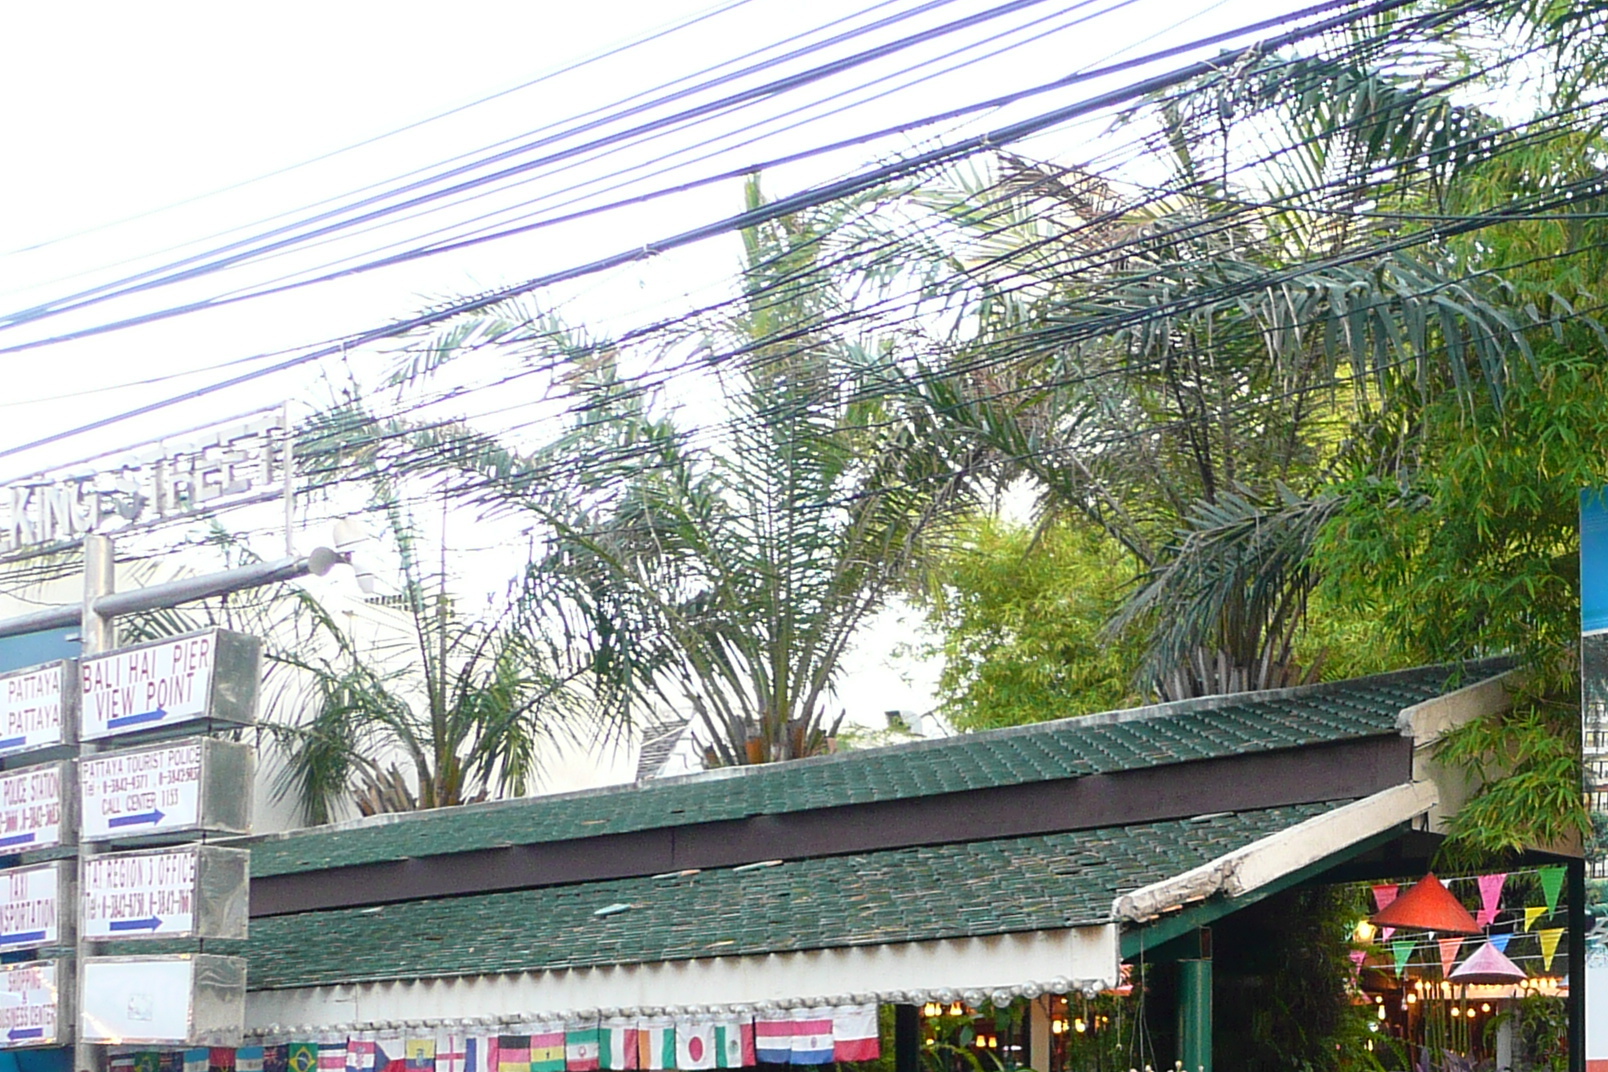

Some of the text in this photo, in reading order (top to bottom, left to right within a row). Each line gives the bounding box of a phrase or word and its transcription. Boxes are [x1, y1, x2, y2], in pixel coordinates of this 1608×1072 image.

[0, 483, 99, 550] KING
[82, 638, 210, 694] BALI HAI PIER
[8, 671, 60, 703] PATTAYA
[96, 673, 195, 721] VIEW POINT
[8, 704, 61, 735] PATTAYA
[83, 746, 201, 780] PATTAYA TOURIST POLICE
[101, 797, 122, 816] CALL
[126, 792, 157, 812] CENTER
[107, 859, 143, 888] REGION
[158, 852, 195, 886] OFFICE
[9, 873, 28, 901] TAXI
[0, 1005, 29, 1028] USINESS
